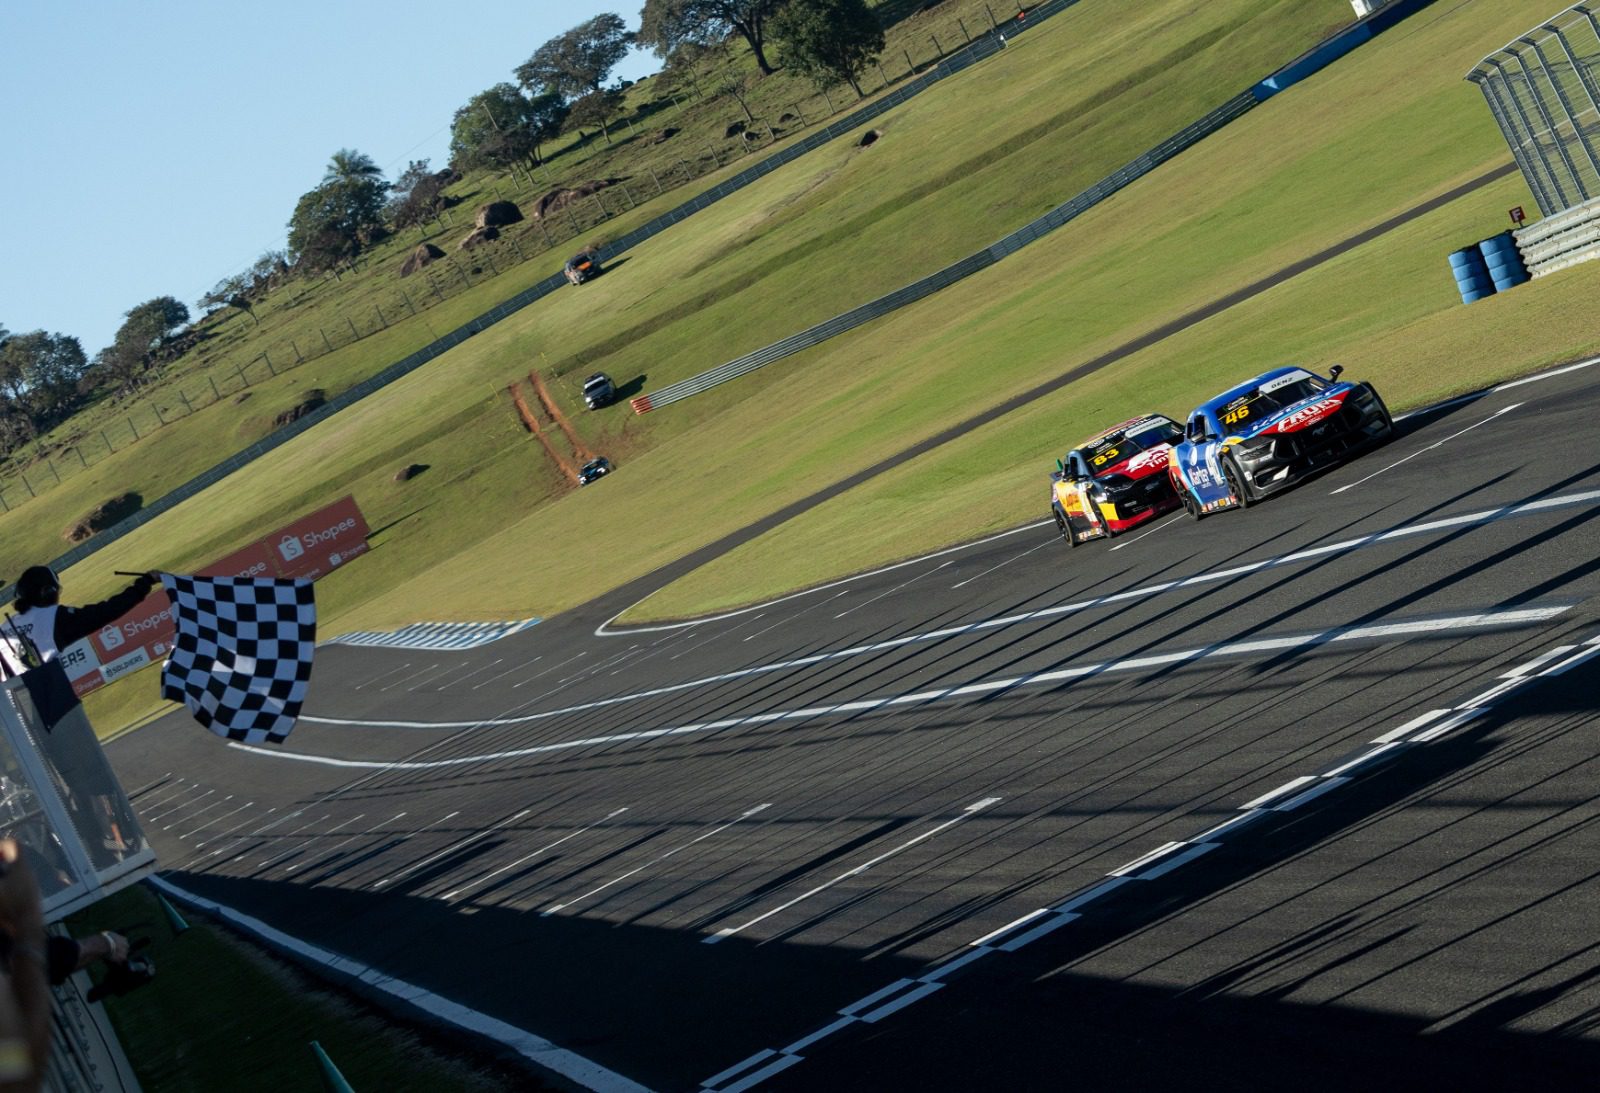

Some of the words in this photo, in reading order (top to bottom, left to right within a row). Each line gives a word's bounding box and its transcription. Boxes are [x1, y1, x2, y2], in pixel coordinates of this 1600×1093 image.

[1511, 208, 1521, 221] F
[1225, 405, 1250, 425] 46
[1093, 448, 1119, 466] 83
[303, 517, 357, 549] Shopee
